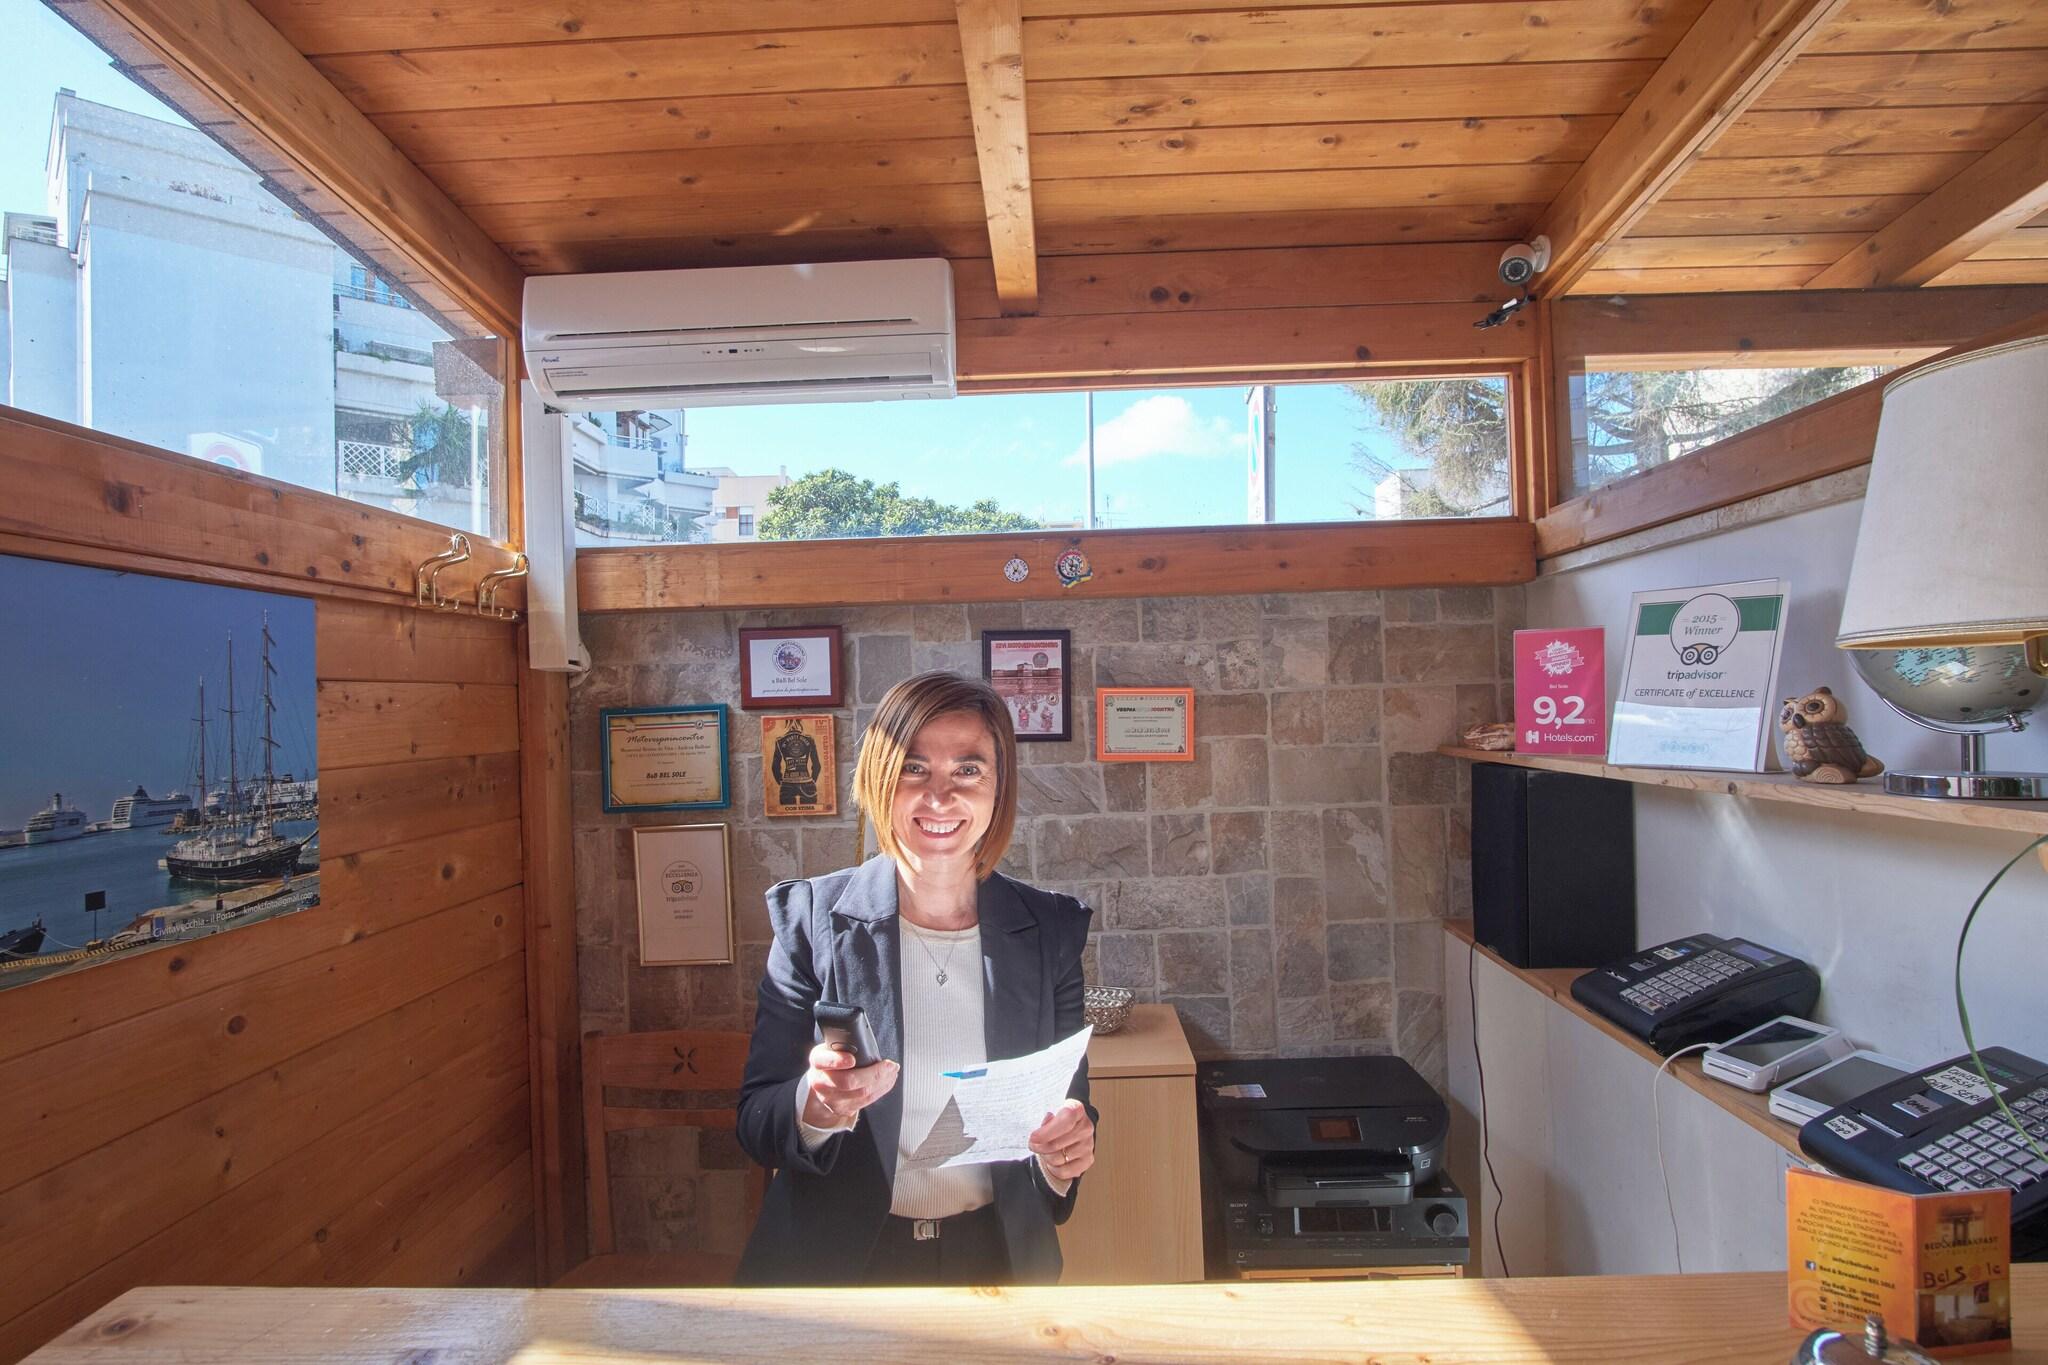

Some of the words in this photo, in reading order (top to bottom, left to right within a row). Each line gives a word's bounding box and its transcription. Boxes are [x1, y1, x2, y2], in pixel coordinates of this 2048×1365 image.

[1692, 615, 1718, 624] 2015
[1684, 626, 1724, 636] Winner
[1667, 670, 1723, 681] tripadvisor
[1634, 688, 1684, 698] CERTIFICATE
[1686, 688, 1696, 699] of
[1699, 689, 1755, 698] EXCELLENCE
[1534, 696, 1586, 730] 9,2
[1544, 732, 1594, 742] Hotels.com
[153, 918, 205, 937] Civitavecchia
[216, 911, 236, 922] Porto
[1940, 1074, 1975, 1088] CASSA
[1952, 1090, 1986, 1101] SERA
[1924, 1268, 1949, 1288] Bel
